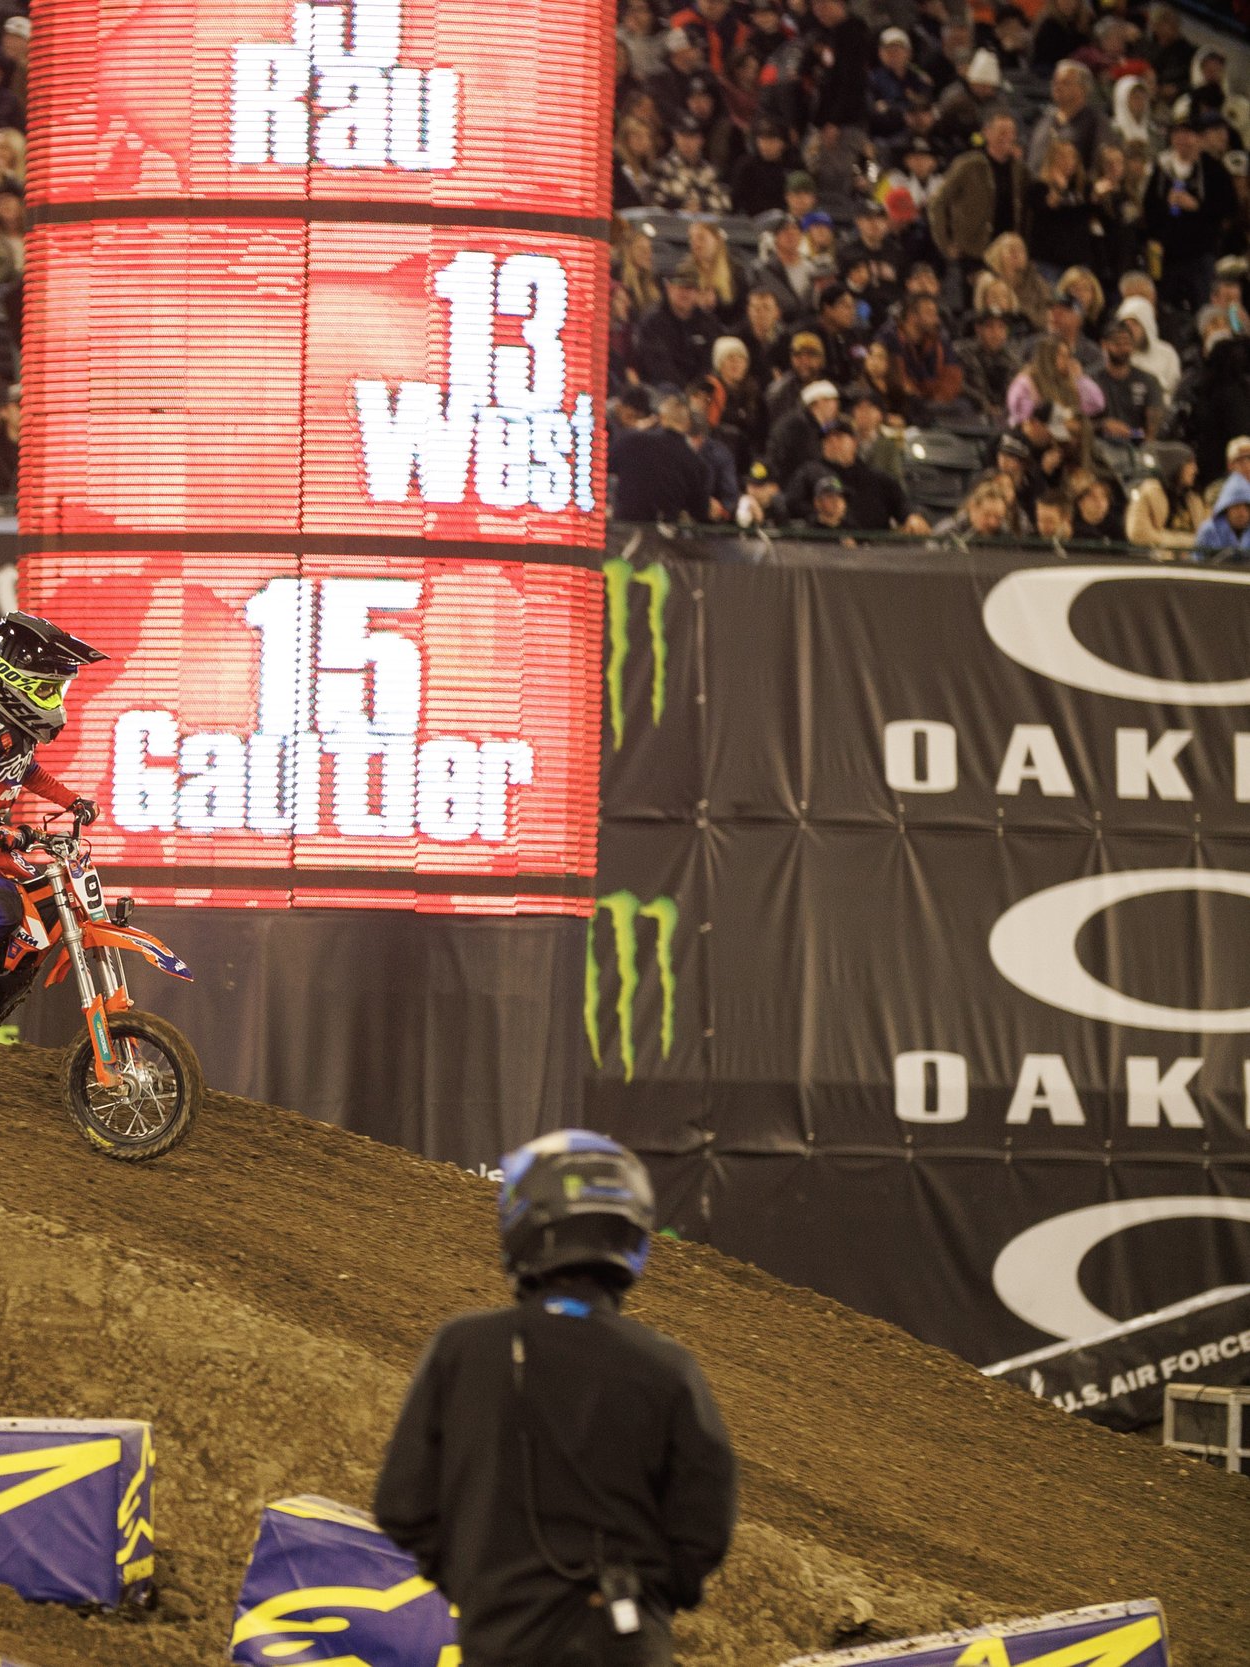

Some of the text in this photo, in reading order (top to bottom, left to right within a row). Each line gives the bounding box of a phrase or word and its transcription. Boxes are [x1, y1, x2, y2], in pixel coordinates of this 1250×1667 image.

[434, 251, 568, 412] 13
[245, 577, 423, 735] 15
[85, 874, 102, 910] 9
[16, 931, 39, 948] KTM
[894, 1050, 1250, 1130] OAK
[1110, 1364, 1159, 1399] AIR
[1160, 1330, 1250, 1380] FORCE
